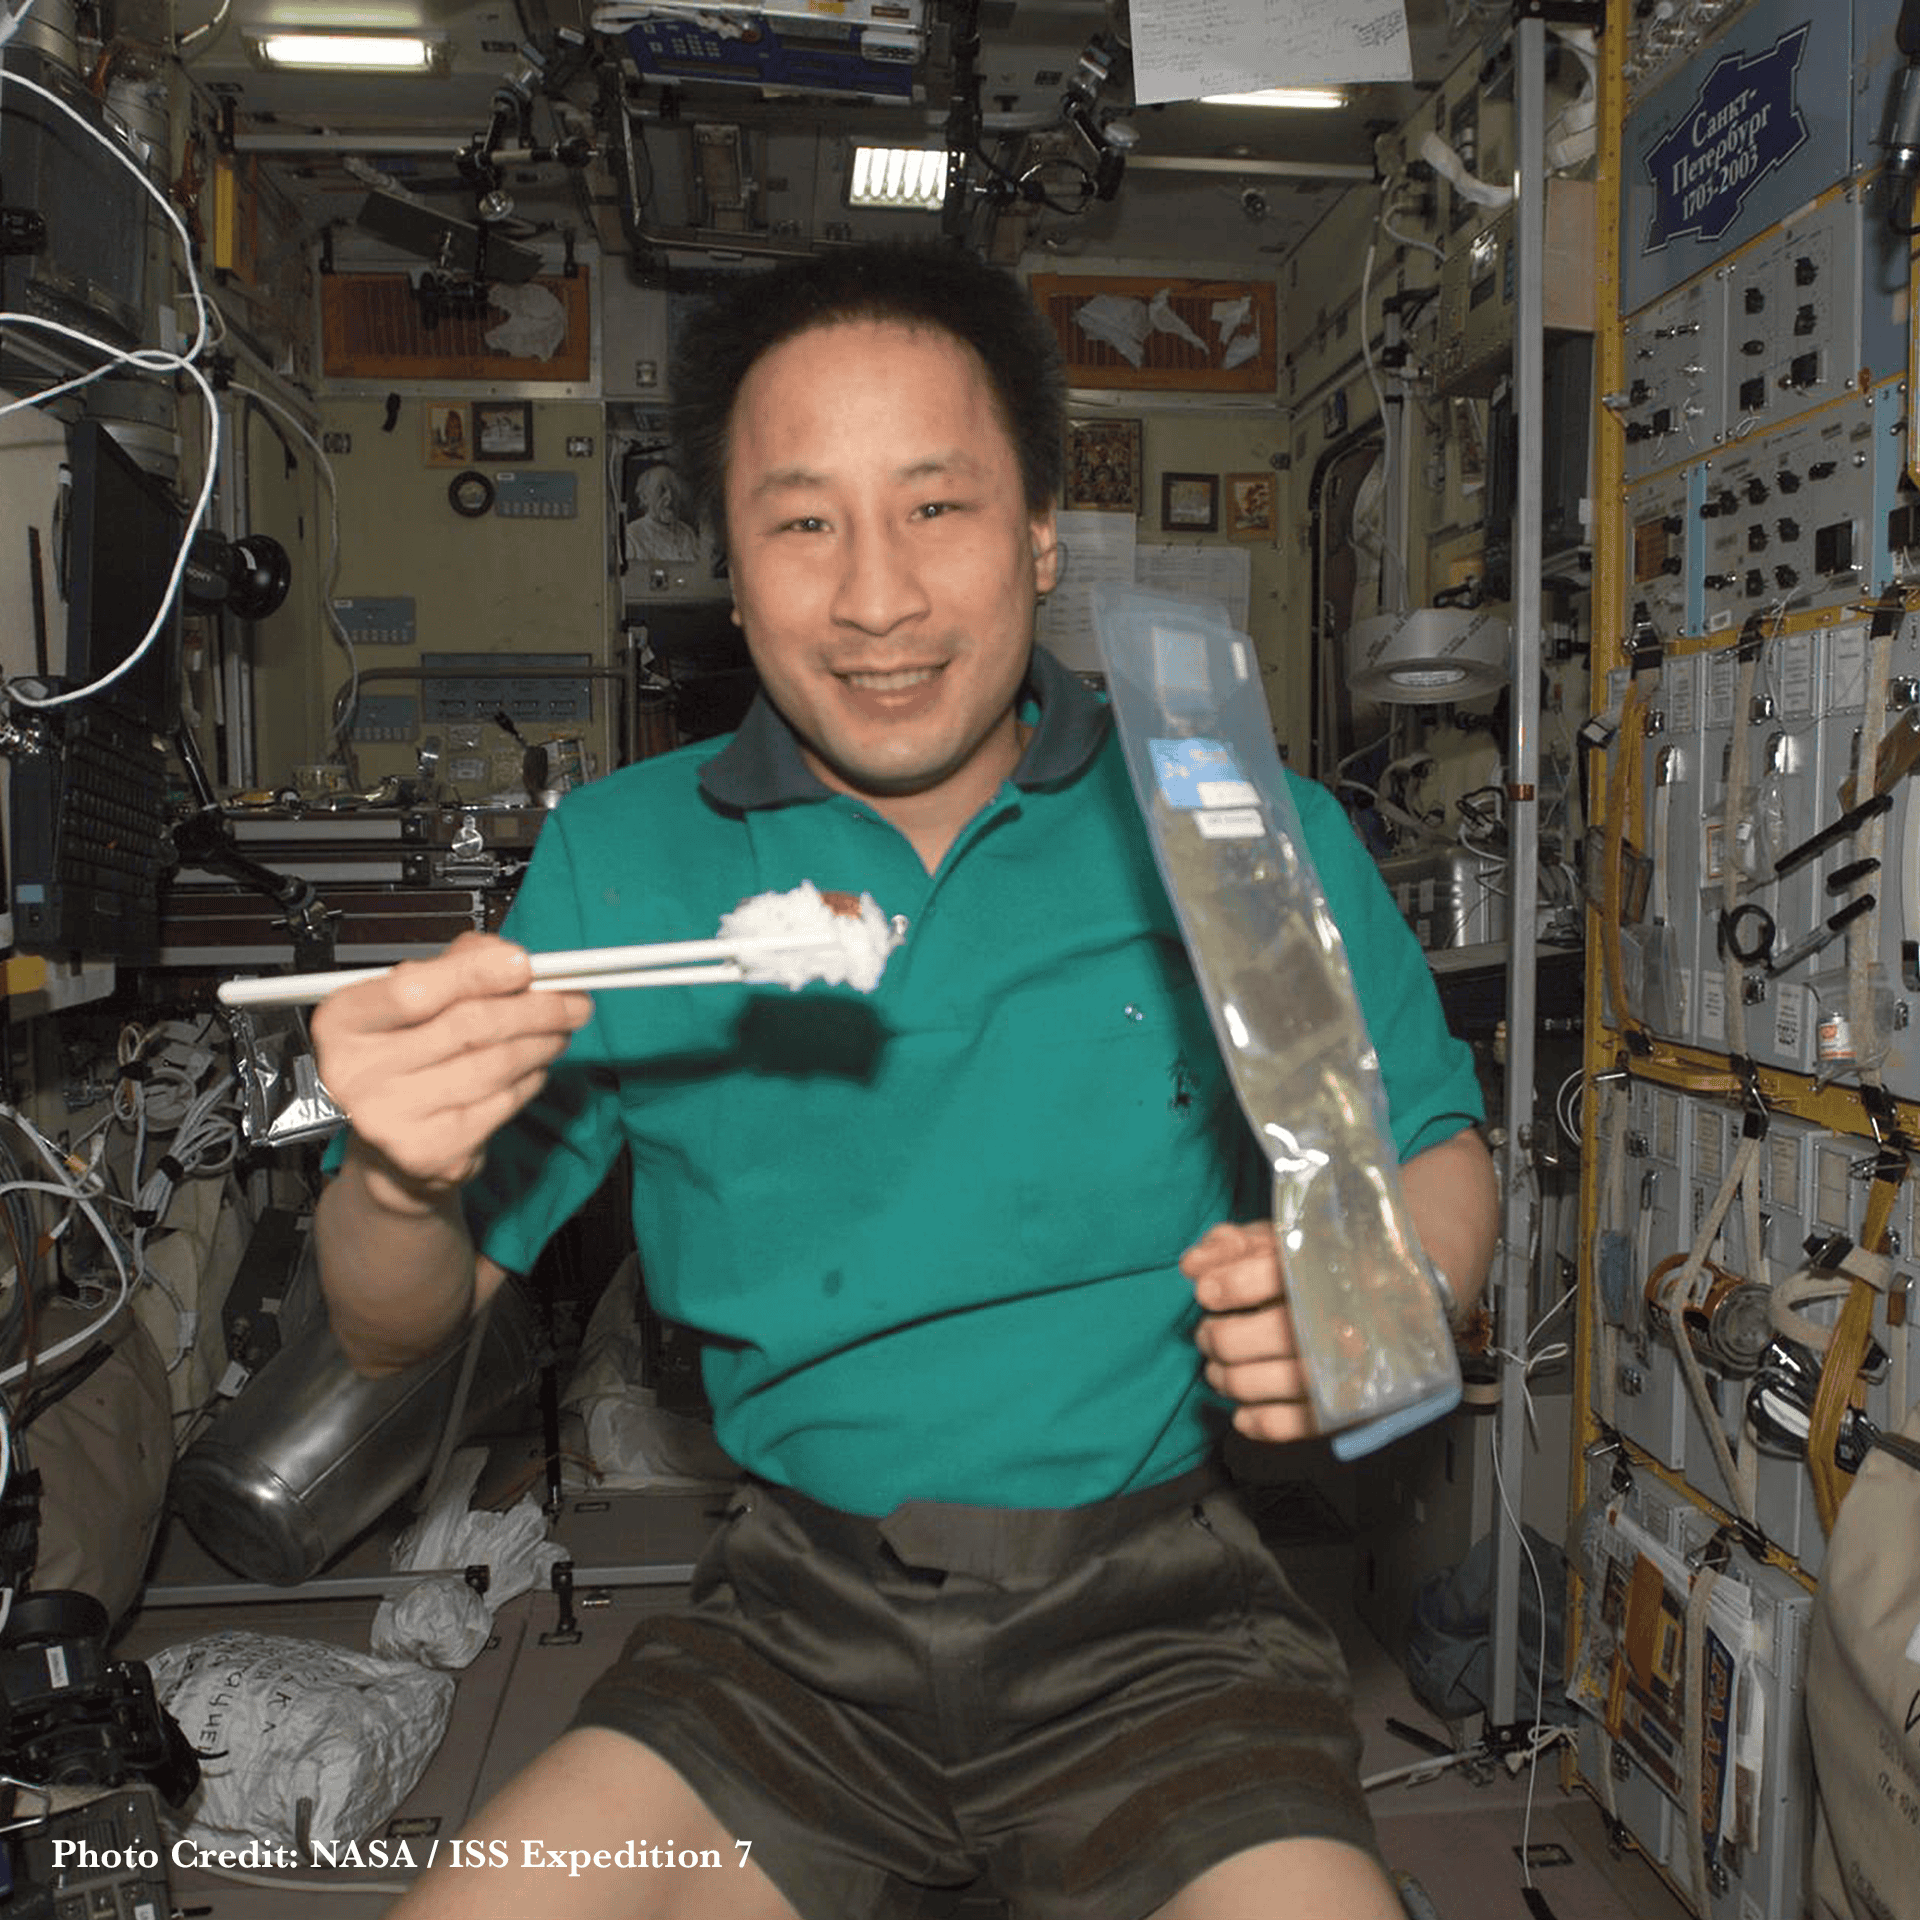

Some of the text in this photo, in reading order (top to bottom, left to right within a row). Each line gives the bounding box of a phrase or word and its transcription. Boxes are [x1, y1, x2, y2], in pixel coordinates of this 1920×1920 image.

[1671, 102, 1772, 196] Петербург
[1692, 88, 1758, 148] Санкт-
[1682, 144, 1758, 221] 1703-2003
